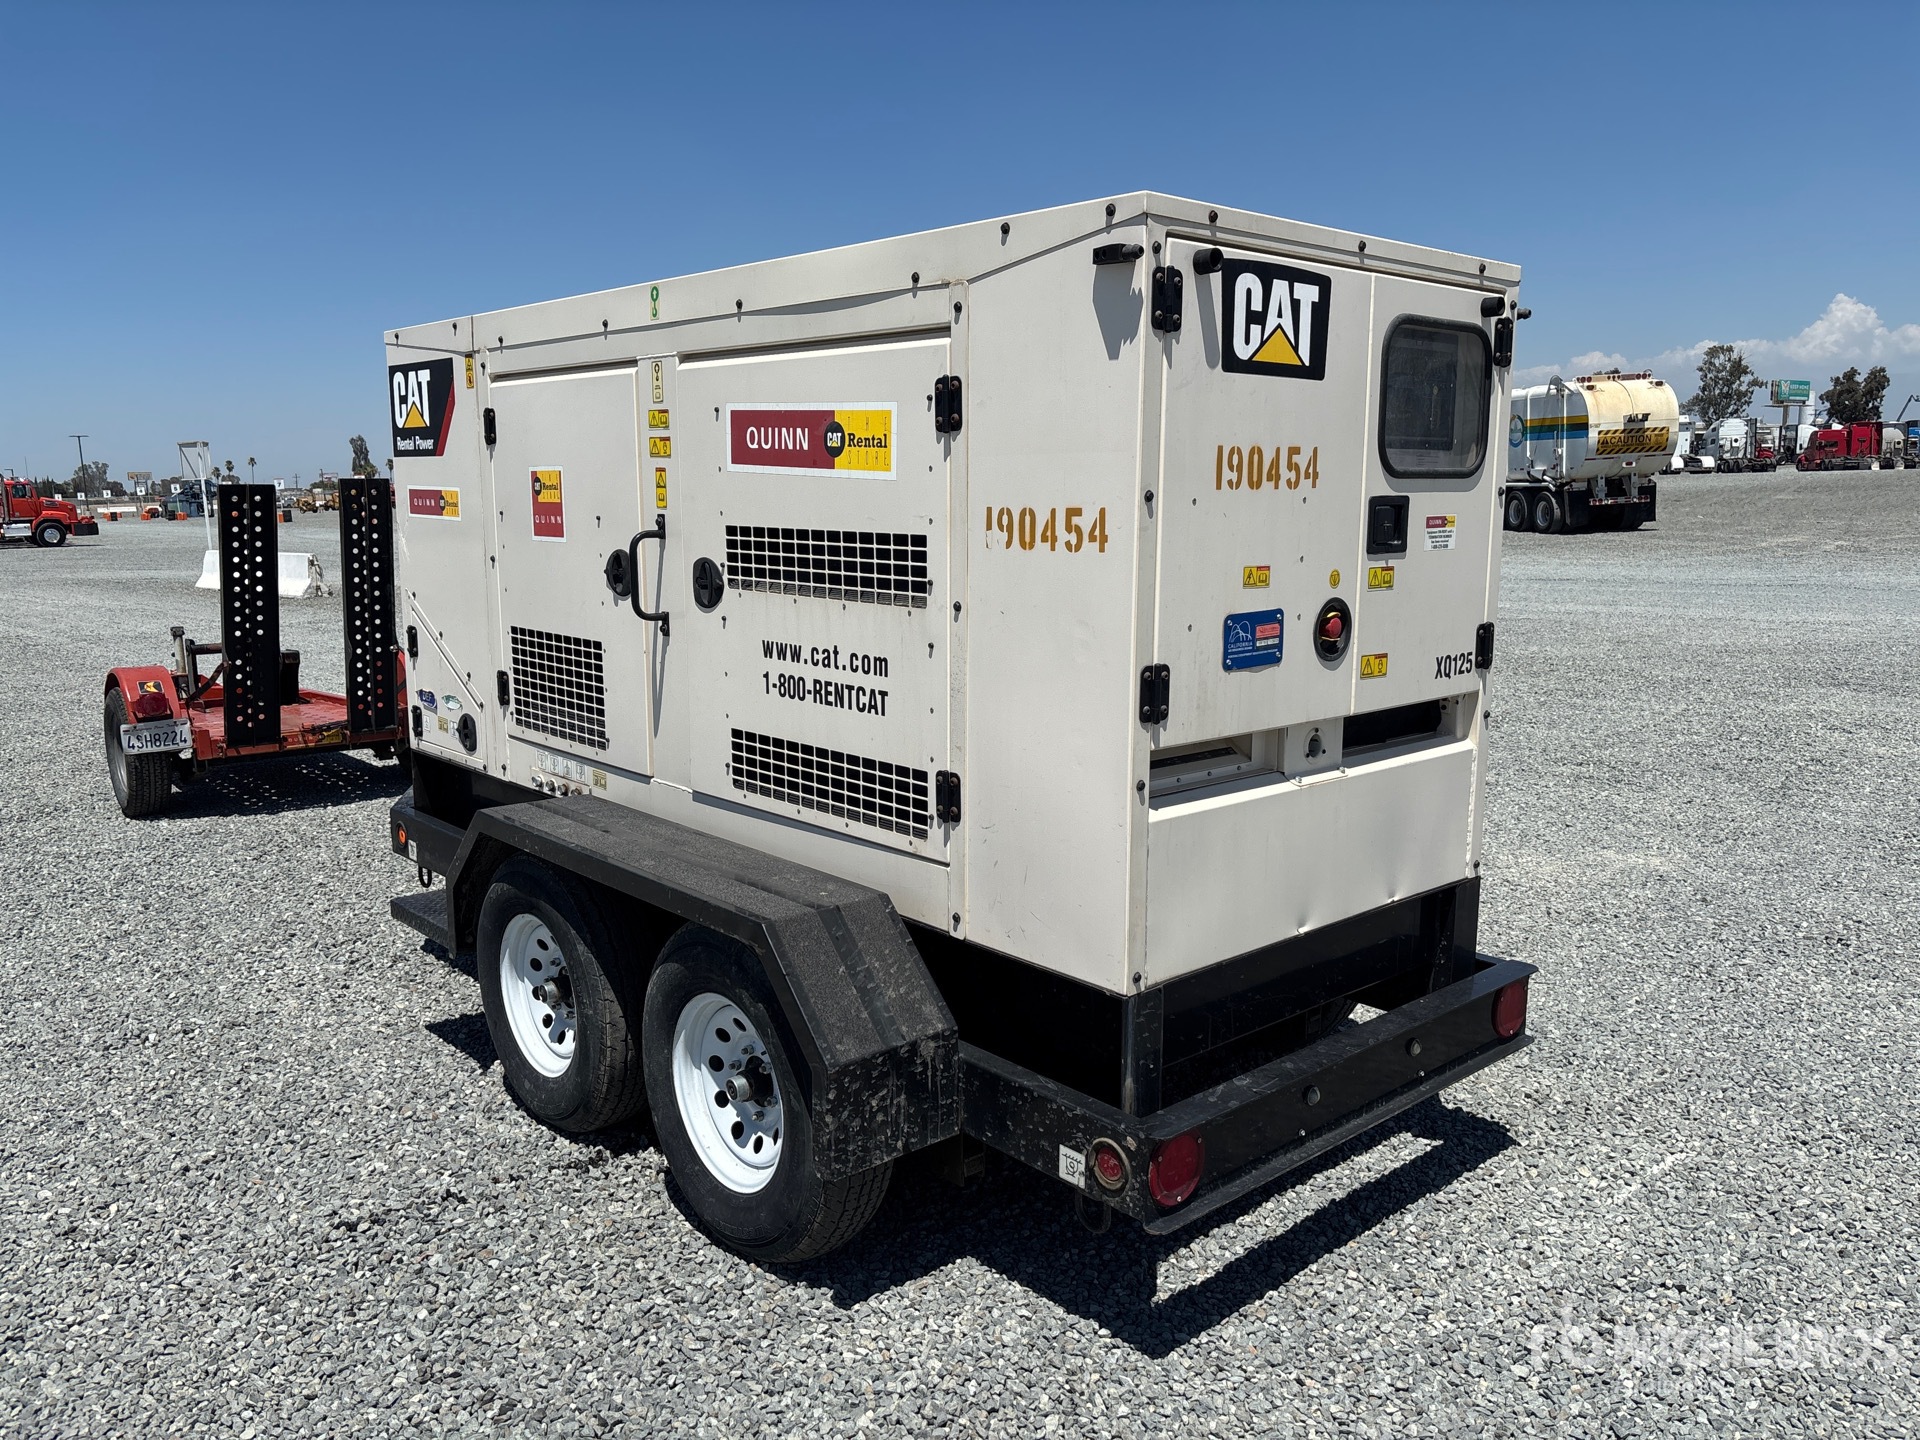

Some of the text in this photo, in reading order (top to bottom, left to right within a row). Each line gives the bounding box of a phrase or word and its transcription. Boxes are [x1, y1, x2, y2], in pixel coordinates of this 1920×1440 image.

[1233, 272, 1320, 367] CAT
[393, 369, 431, 429] CAT
[396, 435, 434, 450] Rental Power
[746, 426, 888, 451] QUINN CAT Rental
[1609, 434, 1652, 445] CAUTION
[1215, 444, 1320, 491] 190454
[542, 482, 559, 491] Rental
[413, 498, 435, 506] QUINN
[535, 515, 562, 524] QUINN
[985, 506, 1109, 554] 190454
[762, 639, 889, 678] www.cat.com
[1435, 651, 1473, 680] XQ125
[762, 671, 889, 717] 1-800-RENTCAT
[127, 730, 188, 750] 4SH8224
